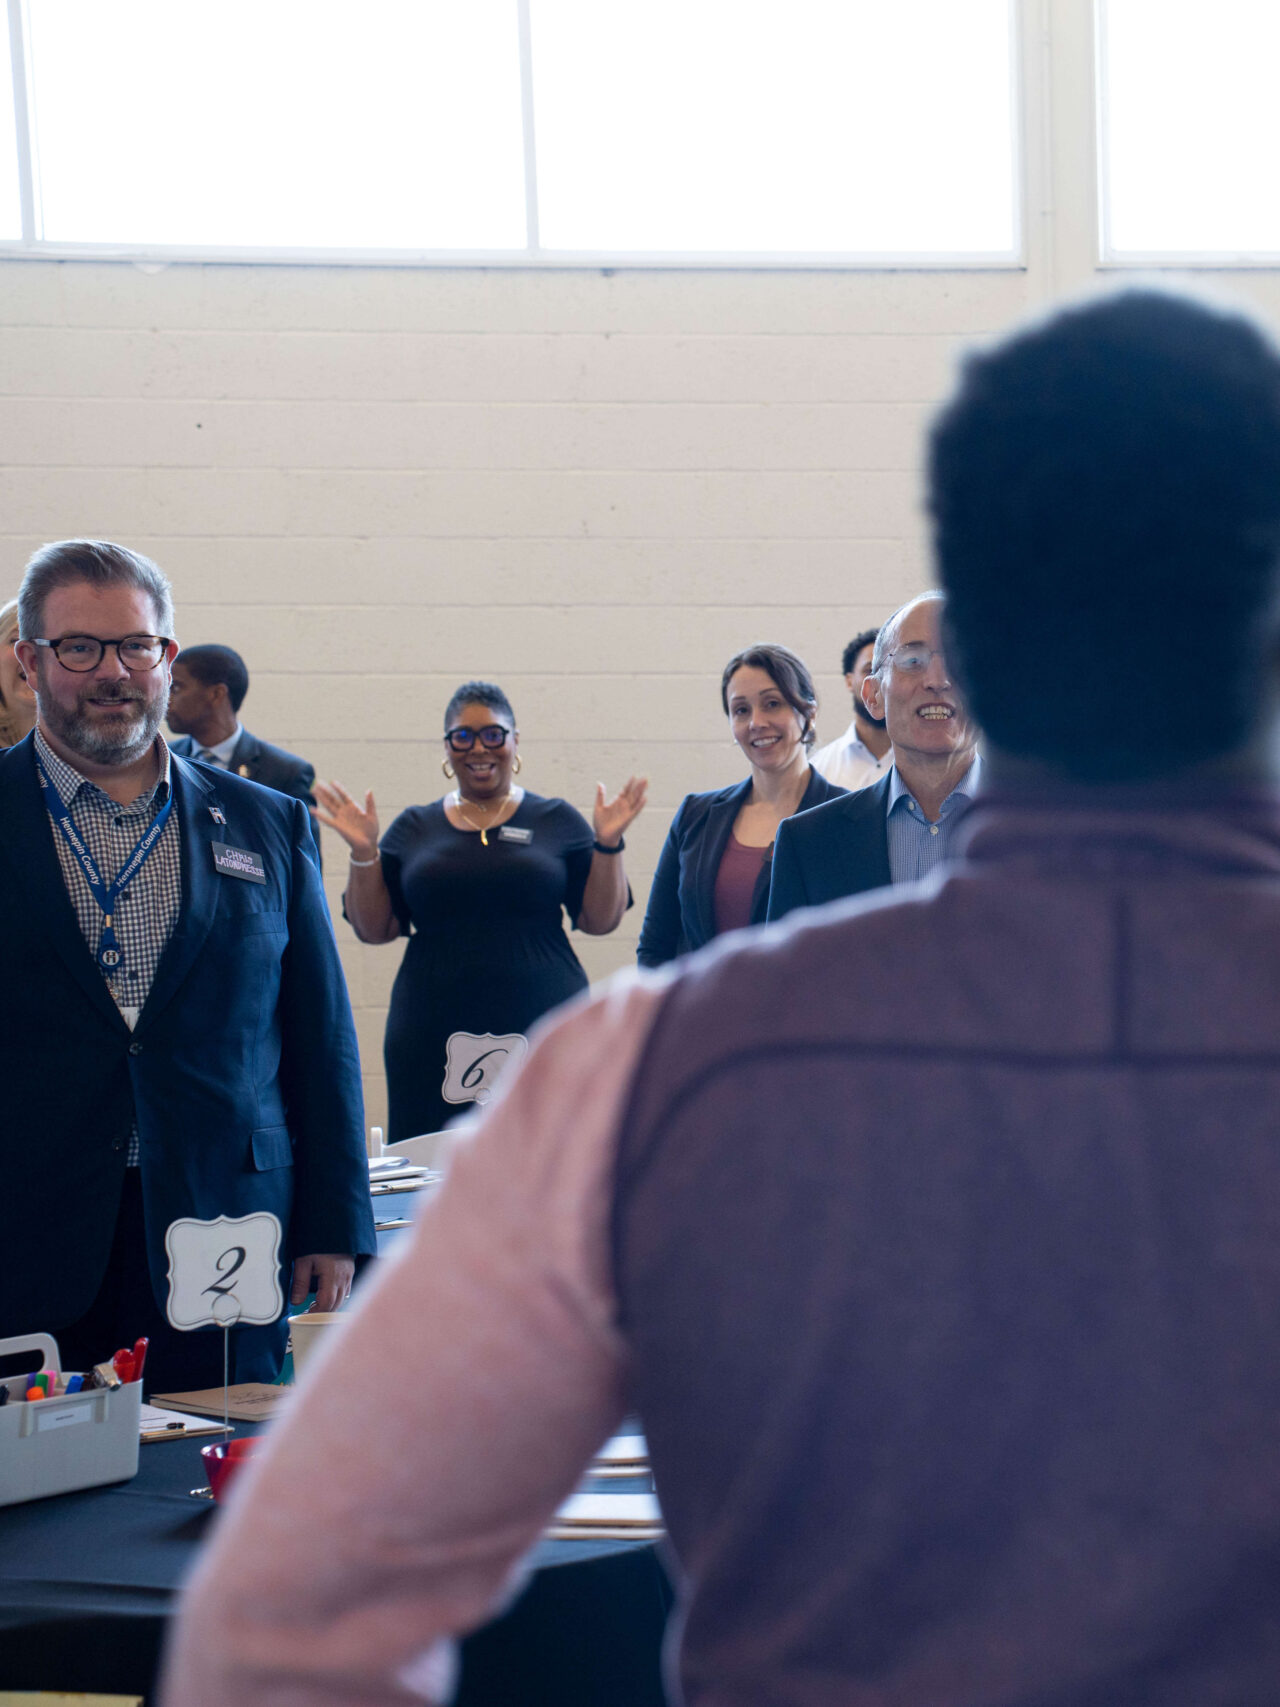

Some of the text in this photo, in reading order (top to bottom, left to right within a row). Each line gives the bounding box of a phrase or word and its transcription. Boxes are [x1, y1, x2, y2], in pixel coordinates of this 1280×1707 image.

[60, 816, 100, 886] Hennepin County
[116, 824, 161, 887] Hennepin County
[461, 1048, 509, 1089] 6
[200, 1246, 246, 1296] 2
